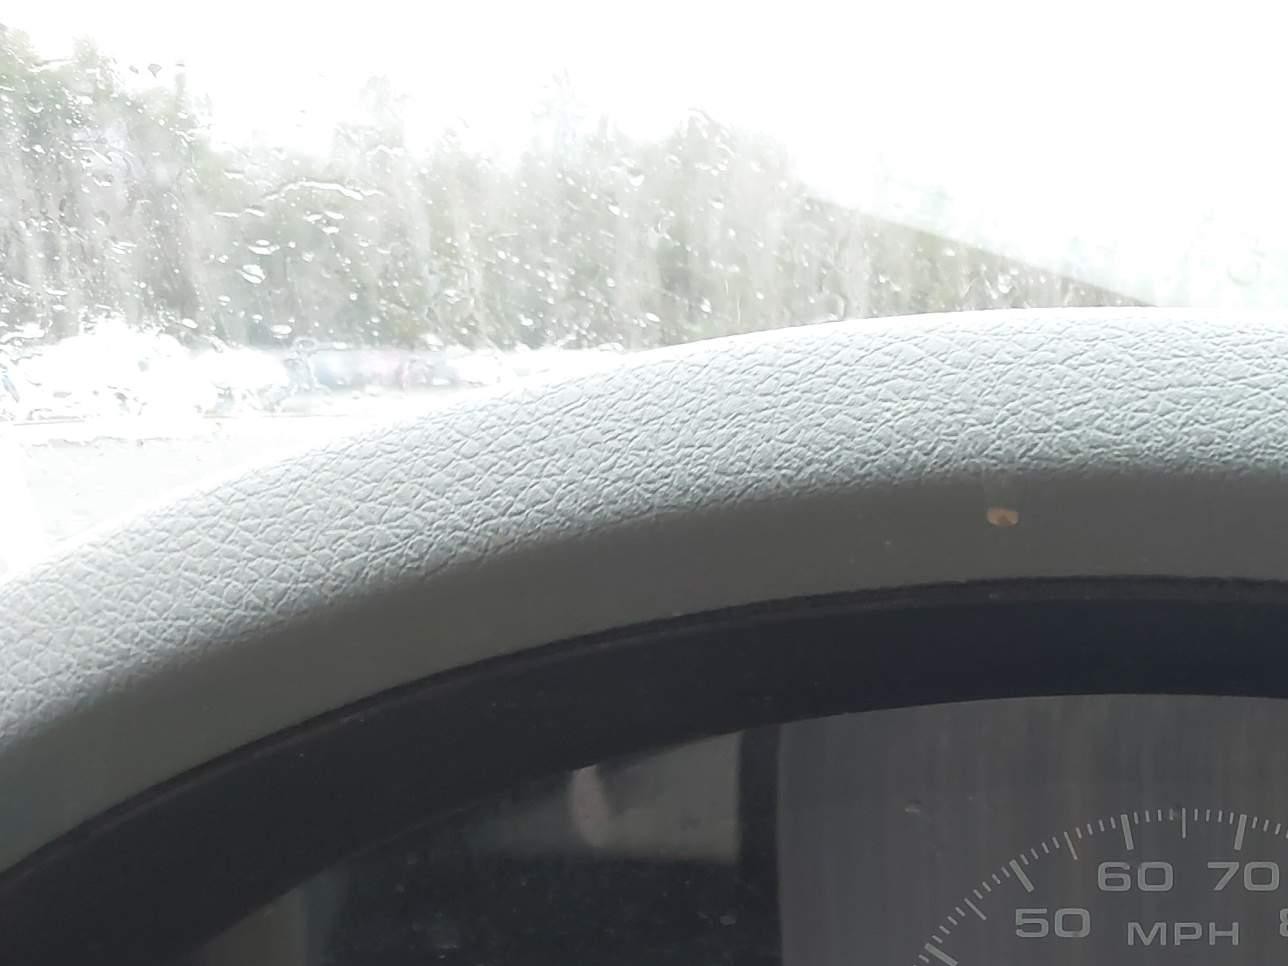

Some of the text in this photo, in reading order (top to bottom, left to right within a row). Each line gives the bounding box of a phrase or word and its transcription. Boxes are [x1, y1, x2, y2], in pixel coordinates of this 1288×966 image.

[1097, 862, 1174, 892] 60
[1207, 862, 1280, 892] 70
[1015, 908, 1091, 938] 50
[1127, 922, 1240, 946] MPH
